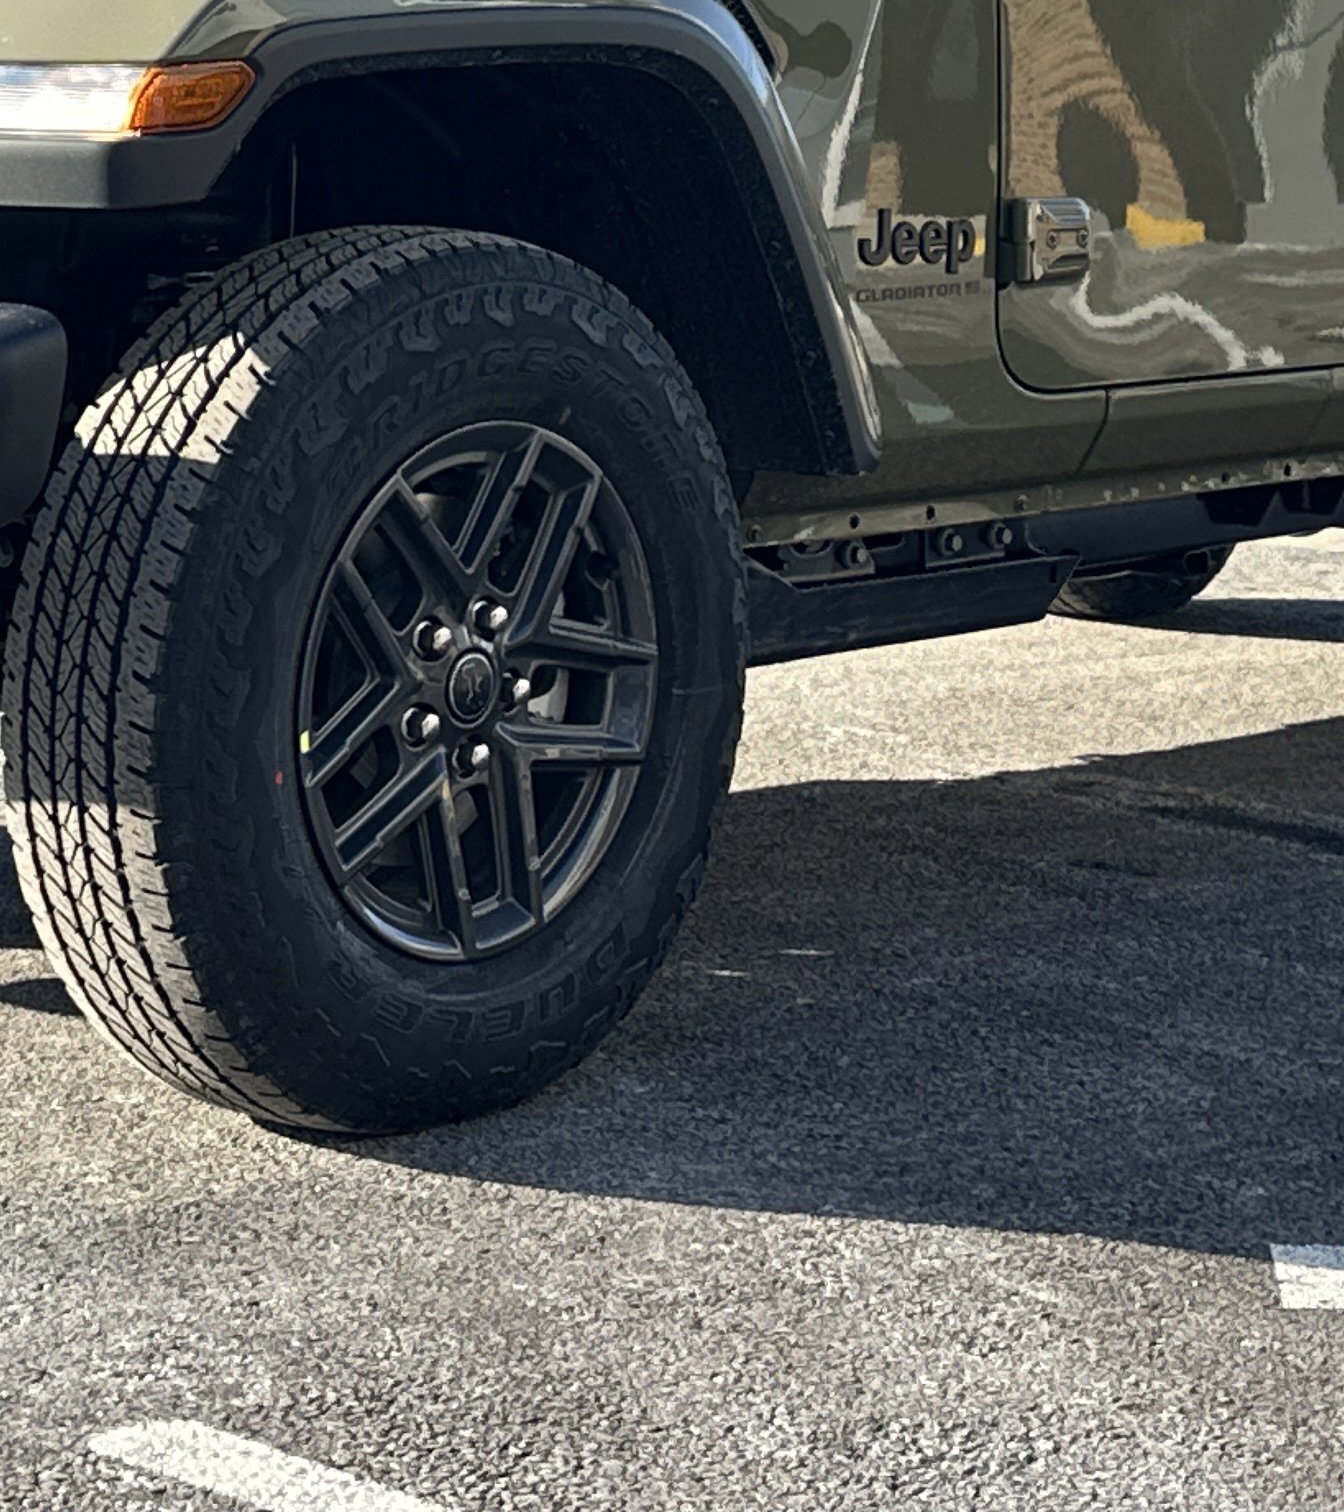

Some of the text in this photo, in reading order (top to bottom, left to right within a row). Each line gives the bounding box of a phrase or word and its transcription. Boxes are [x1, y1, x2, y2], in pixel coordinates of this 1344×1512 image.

[858, 208, 976, 274] Jeep
[856, 283, 963, 303] GLADIATOR
[327, 338, 703, 511] BRIDGESTONE
[325, 920, 631, 1044] DUELER
